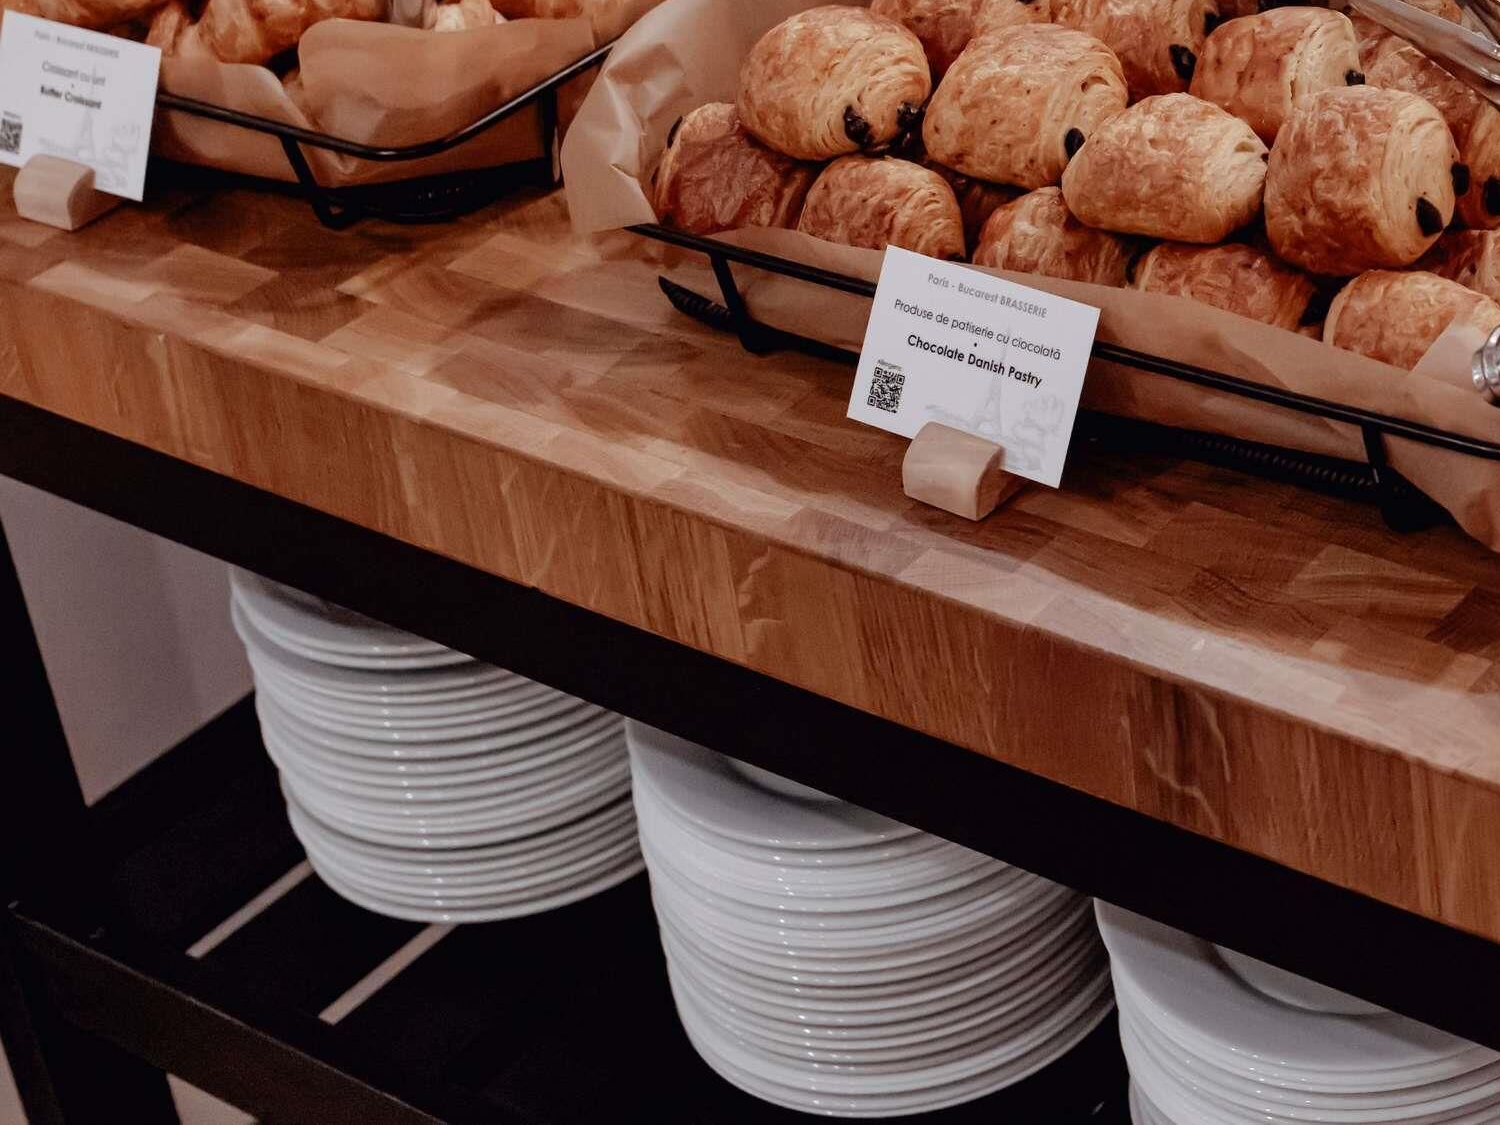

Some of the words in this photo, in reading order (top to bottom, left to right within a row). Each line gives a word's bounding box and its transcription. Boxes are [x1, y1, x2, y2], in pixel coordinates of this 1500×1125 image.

[928, 273, 949, 288] Paris
[958, 281, 998, 304] Bucarest
[1000, 295, 1048, 318] BRASSERIE
[894, 298, 933, 320] Produse
[936, 312, 949, 325] de
[951, 317, 994, 340] patiserie
[996, 332, 1010, 345] cu
[908, 334, 965, 362] Chocolate
[967, 353, 1005, 376] Danish
[1008, 366, 1042, 388] Pastry
